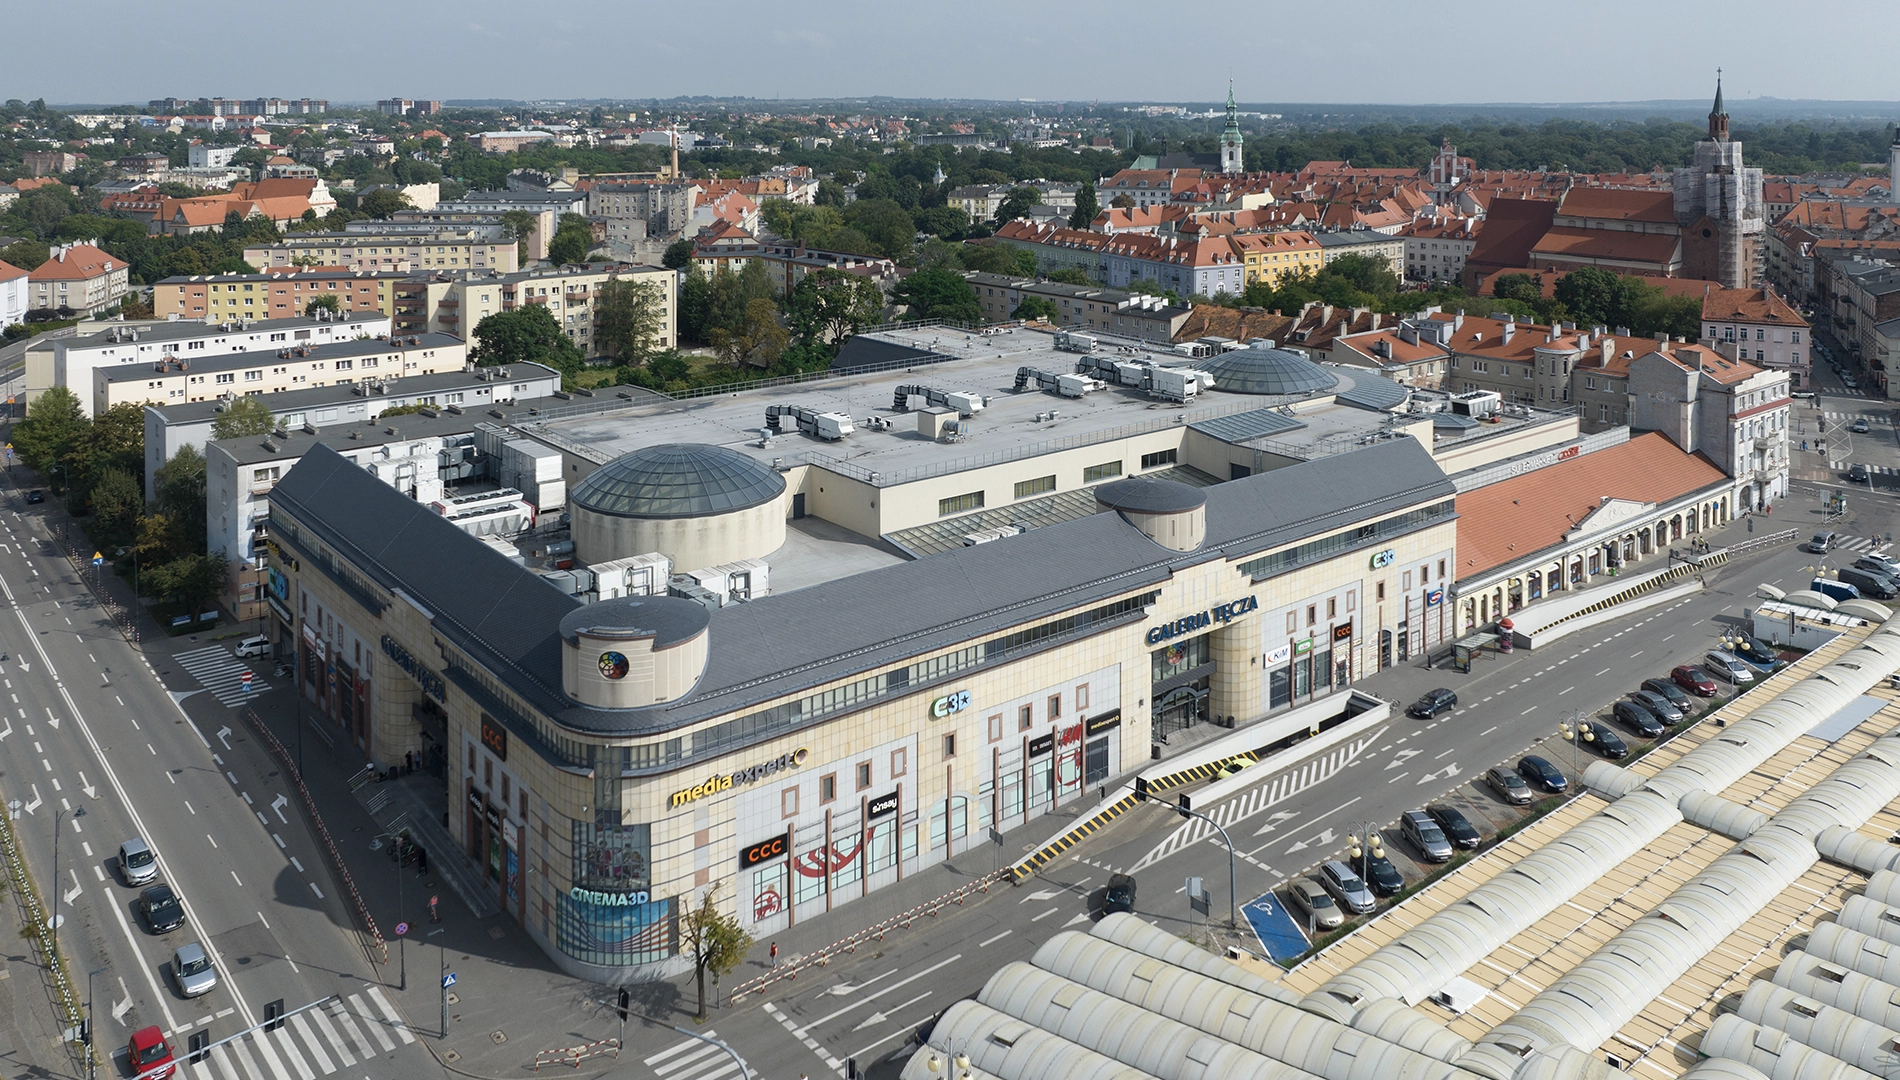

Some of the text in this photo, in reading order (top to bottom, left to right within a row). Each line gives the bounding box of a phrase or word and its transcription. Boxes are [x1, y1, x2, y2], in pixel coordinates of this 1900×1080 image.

[1147, 595, 1258, 644] GALERIA TĘCZA
[1337, 626, 1351, 637] CCC
[482, 724, 502, 751] CCC
[872, 797, 897, 813] sinsay
[748, 839, 782, 862] CCC
[570, 887, 649, 907] CINEMA3D
